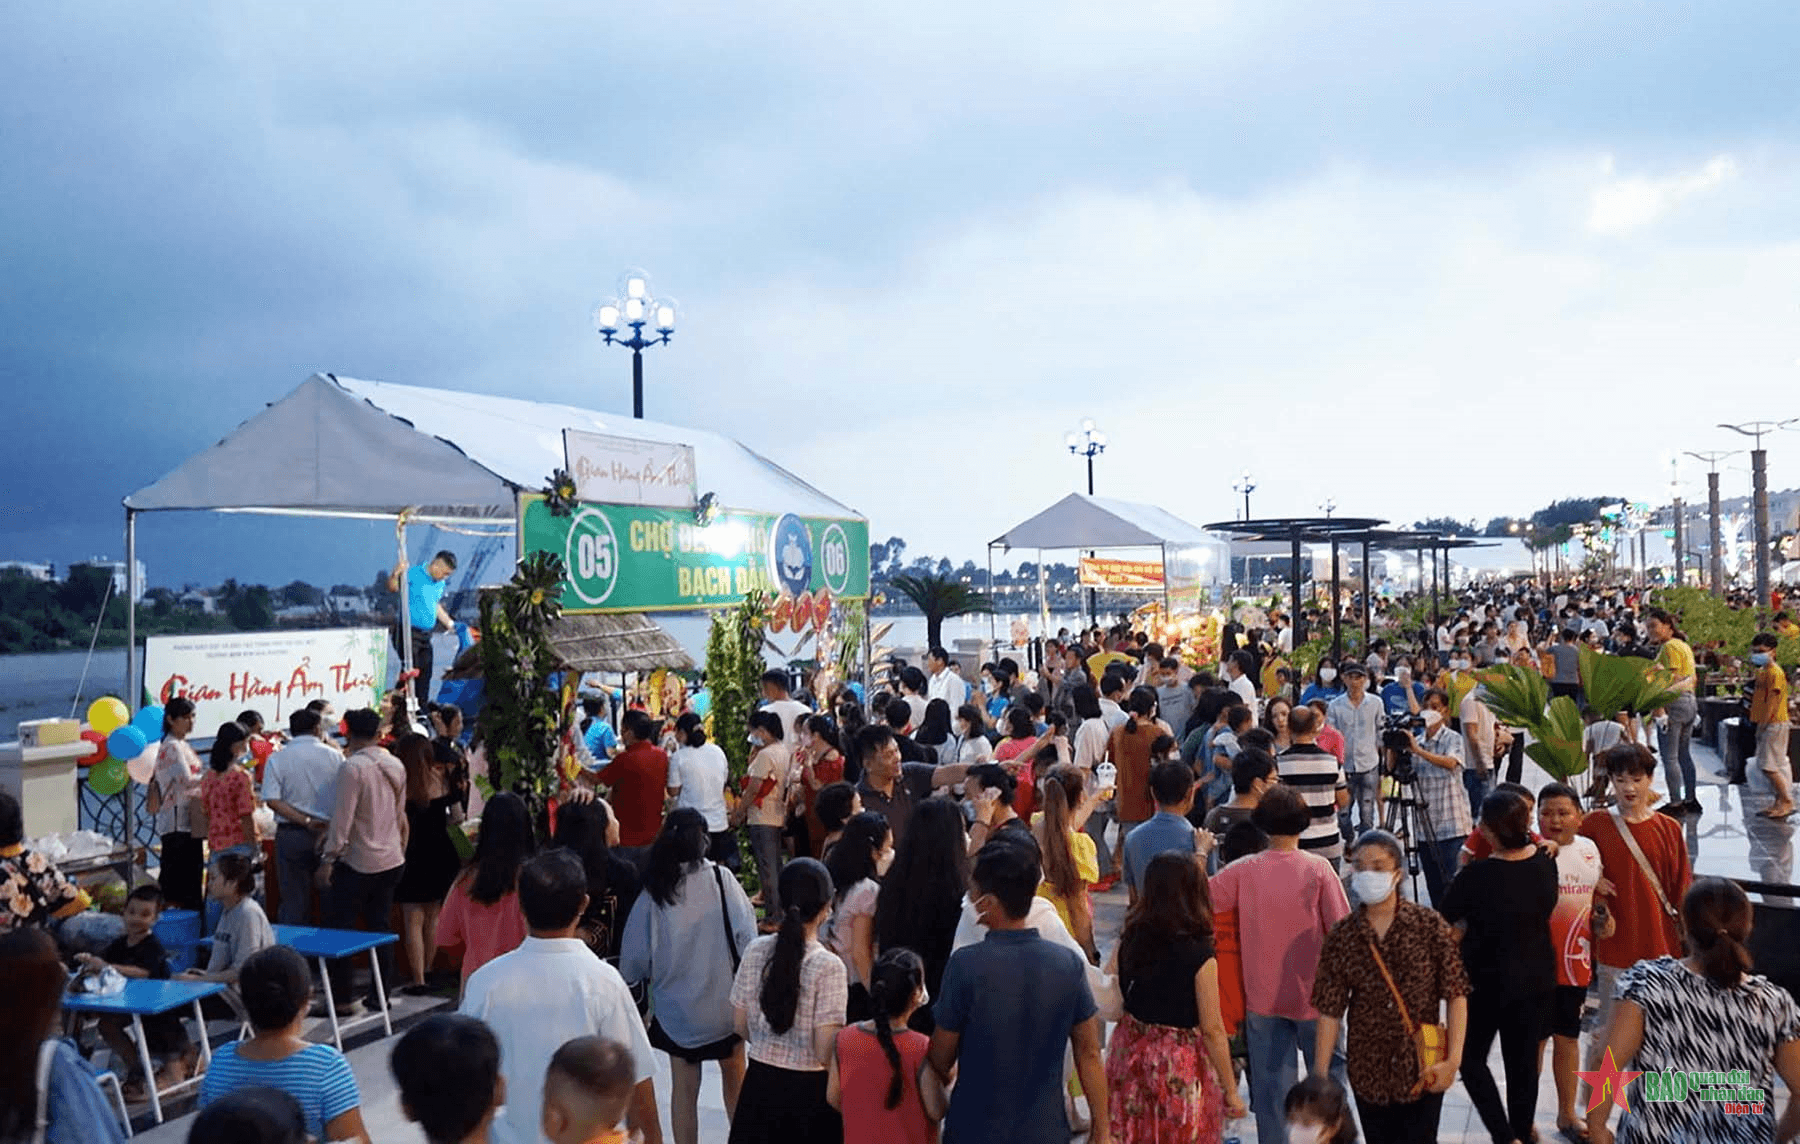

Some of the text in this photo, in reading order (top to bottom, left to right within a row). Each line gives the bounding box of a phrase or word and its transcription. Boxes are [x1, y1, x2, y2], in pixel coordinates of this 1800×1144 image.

[578, 533, 611, 579] 05
[629, 519, 675, 560] CHỢ
[825, 541, 845, 576] 06
[678, 566, 731, 603] BẠCH
[160, 672, 223, 705] Gian
[228, 671, 282, 722] Hàng
